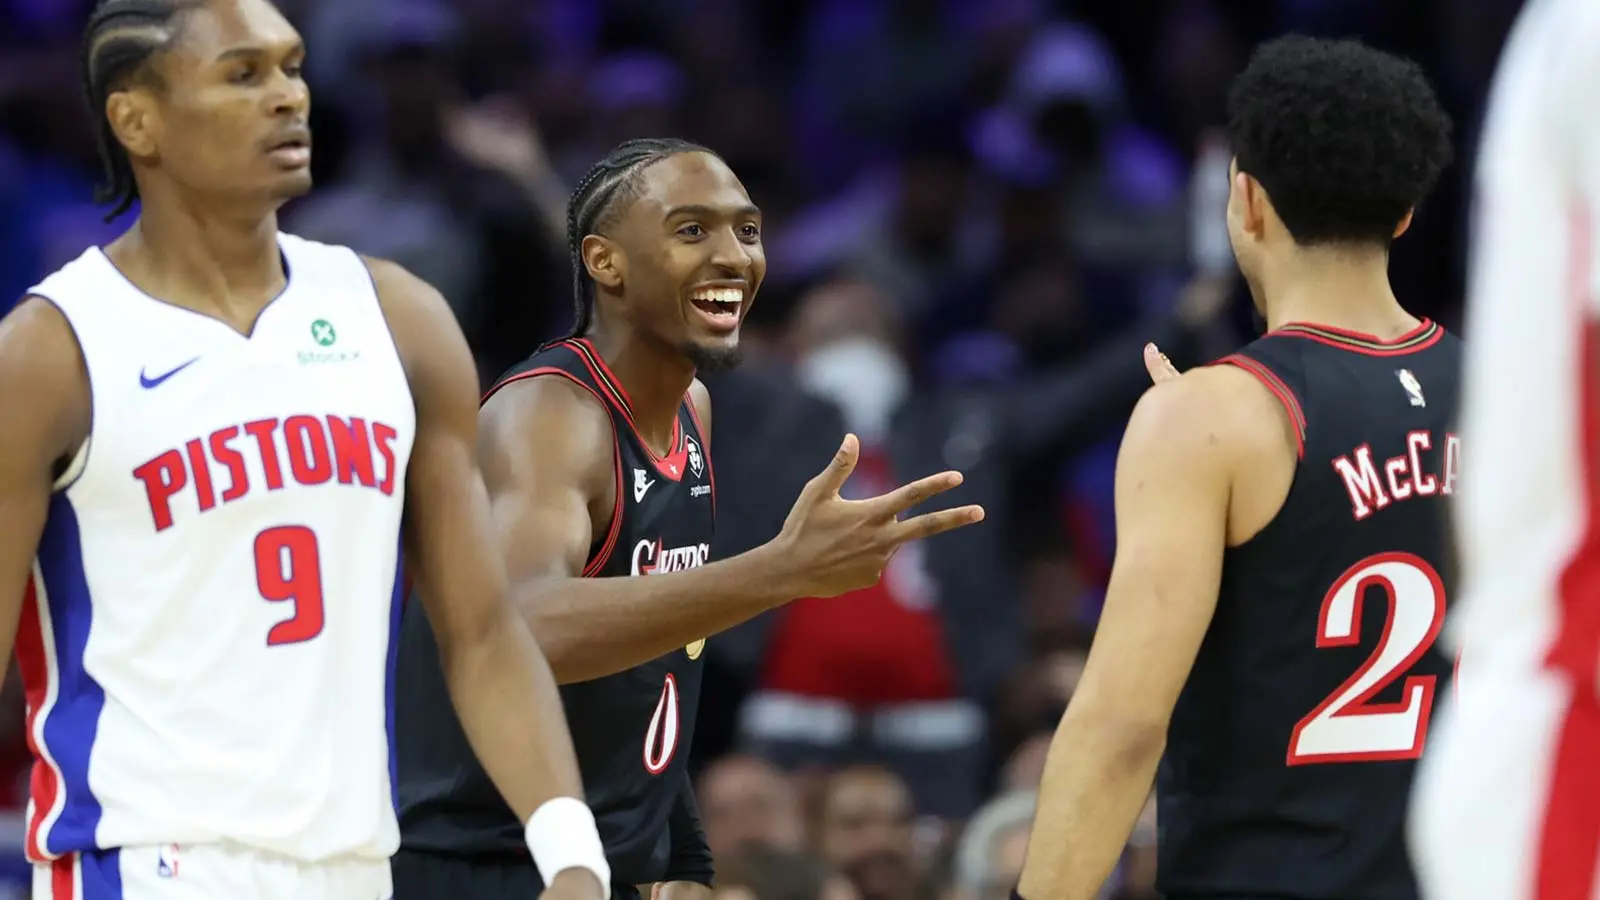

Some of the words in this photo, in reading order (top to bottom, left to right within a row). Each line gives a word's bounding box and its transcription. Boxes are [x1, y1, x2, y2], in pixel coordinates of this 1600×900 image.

[132, 413, 397, 532] PISTONS
[252, 524, 324, 647] 9
[1286, 551, 1460, 767] 2
[642, 672, 680, 775] 0
